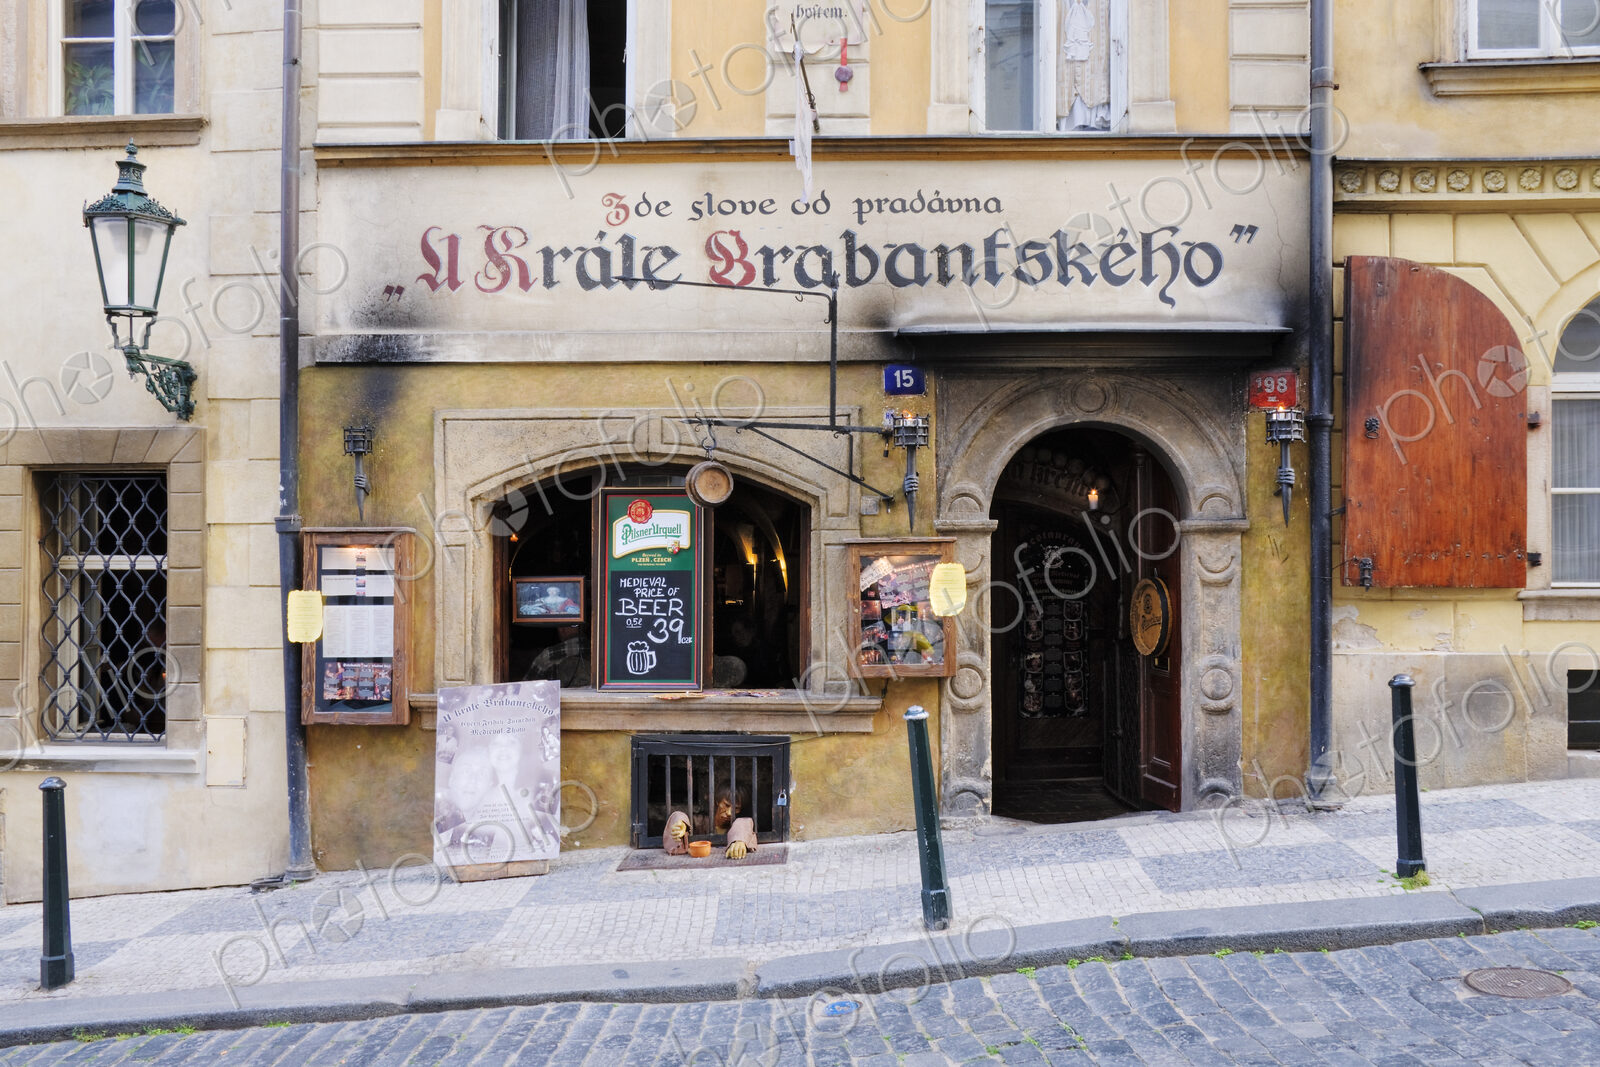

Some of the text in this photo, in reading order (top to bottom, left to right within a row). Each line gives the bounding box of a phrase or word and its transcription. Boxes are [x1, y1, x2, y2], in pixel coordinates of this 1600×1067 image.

[601, 189, 1004, 226] Zde slove od pradávna
[474, 223, 683, 293] Krále
[894, 369, 914, 388] 15
[1255, 376, 1288, 393] 198
[621, 523, 682, 545] Pilsner Urquell
[619, 577, 667, 588] MEDIEVAL
[634, 587, 680, 598] PRICE OF
[615, 598, 684, 616] BEER
[647, 618, 684, 644] 39
